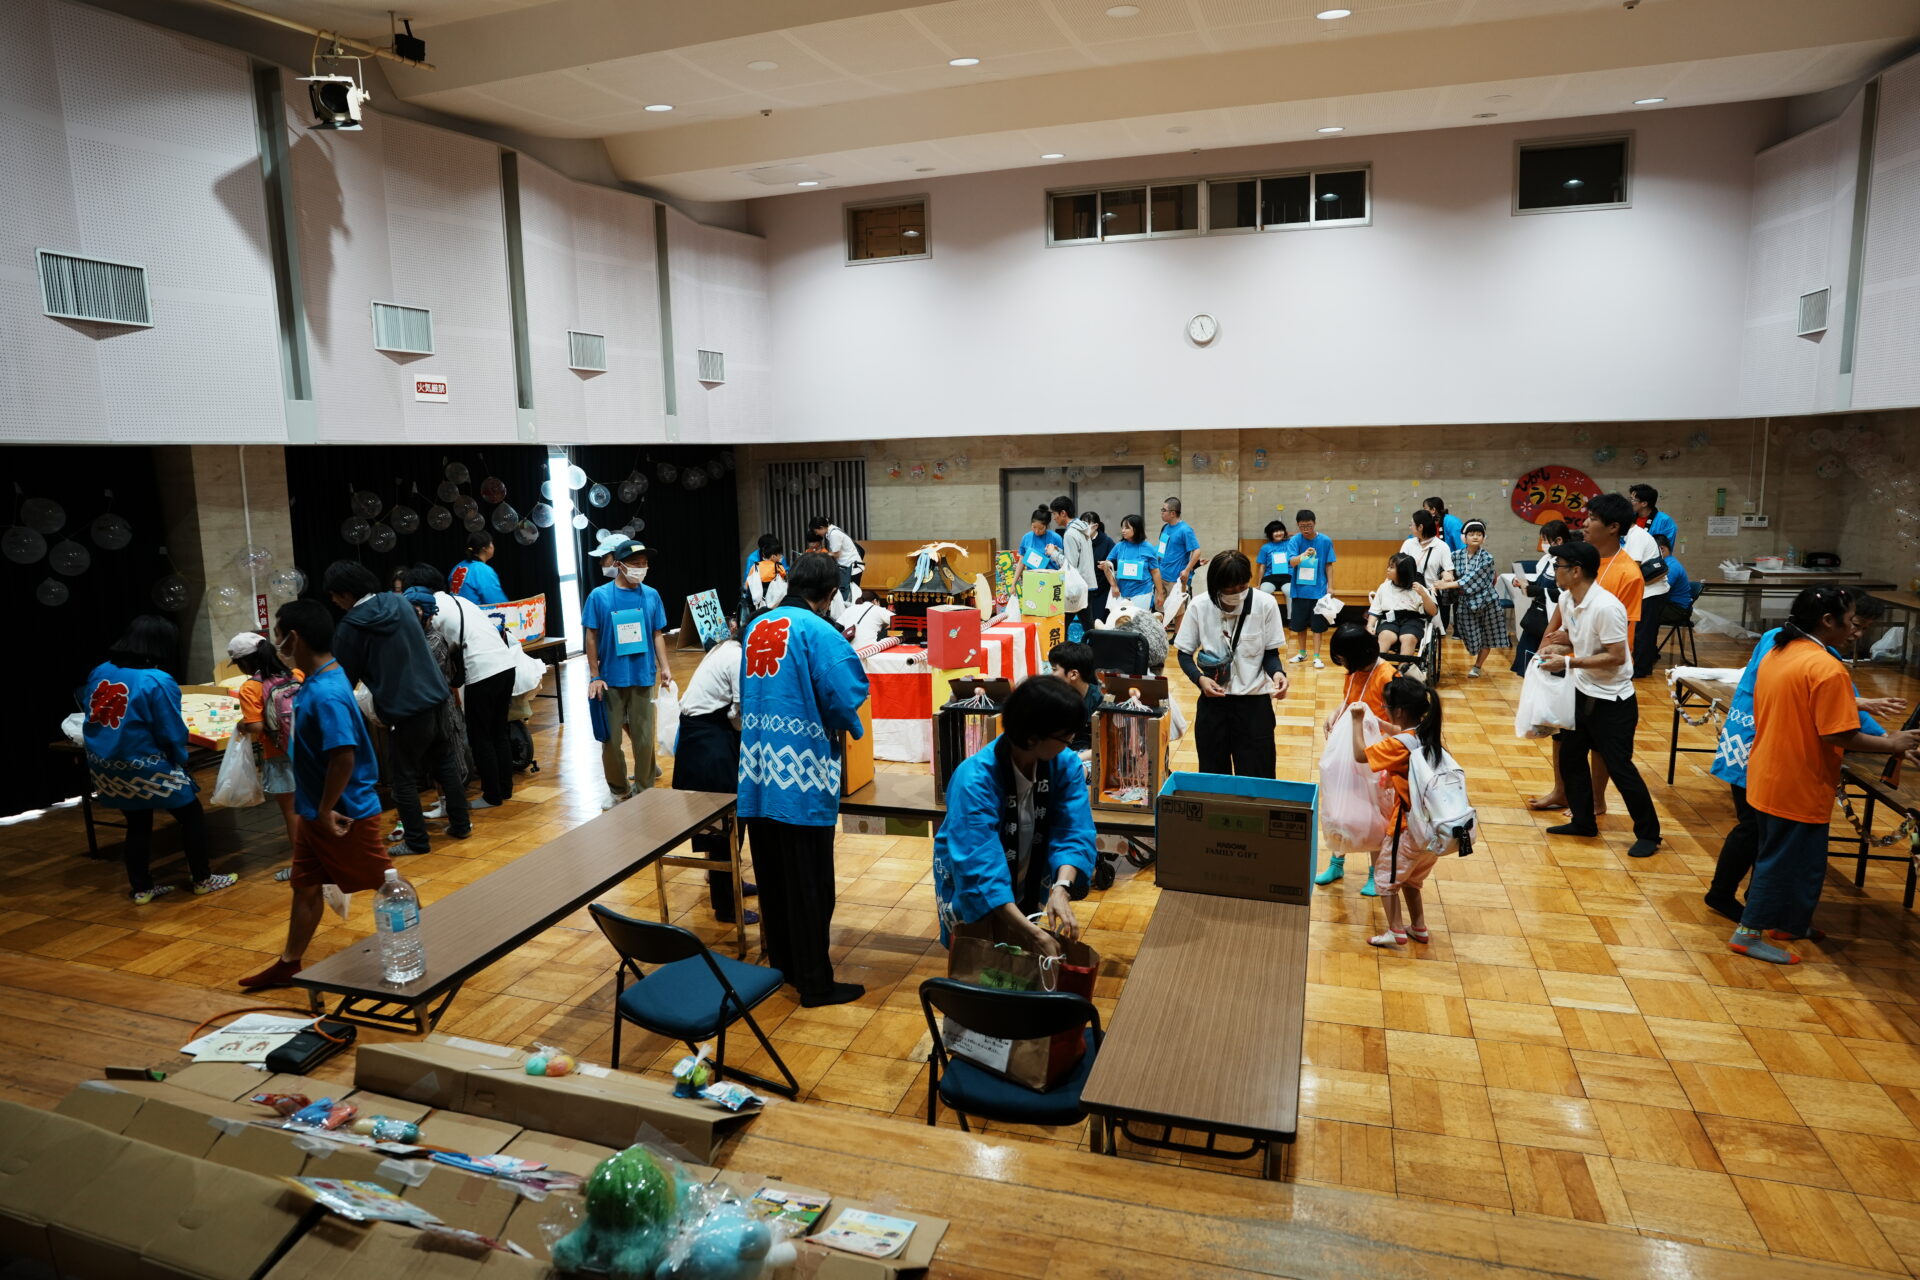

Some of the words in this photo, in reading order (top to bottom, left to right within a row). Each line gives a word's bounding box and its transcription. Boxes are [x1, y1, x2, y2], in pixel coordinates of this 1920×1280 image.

[1053, 585, 1062, 602] 夏
[258, 597, 268, 626] 消火器
[704, 613, 719, 631] つり
[746, 616, 791, 679] 祭
[1049, 627, 1061, 648] 祭
[89, 679, 130, 730] 祭
[1205, 846, 1236, 858] FAMILY
[1237, 850, 1260, 861] GIFT
